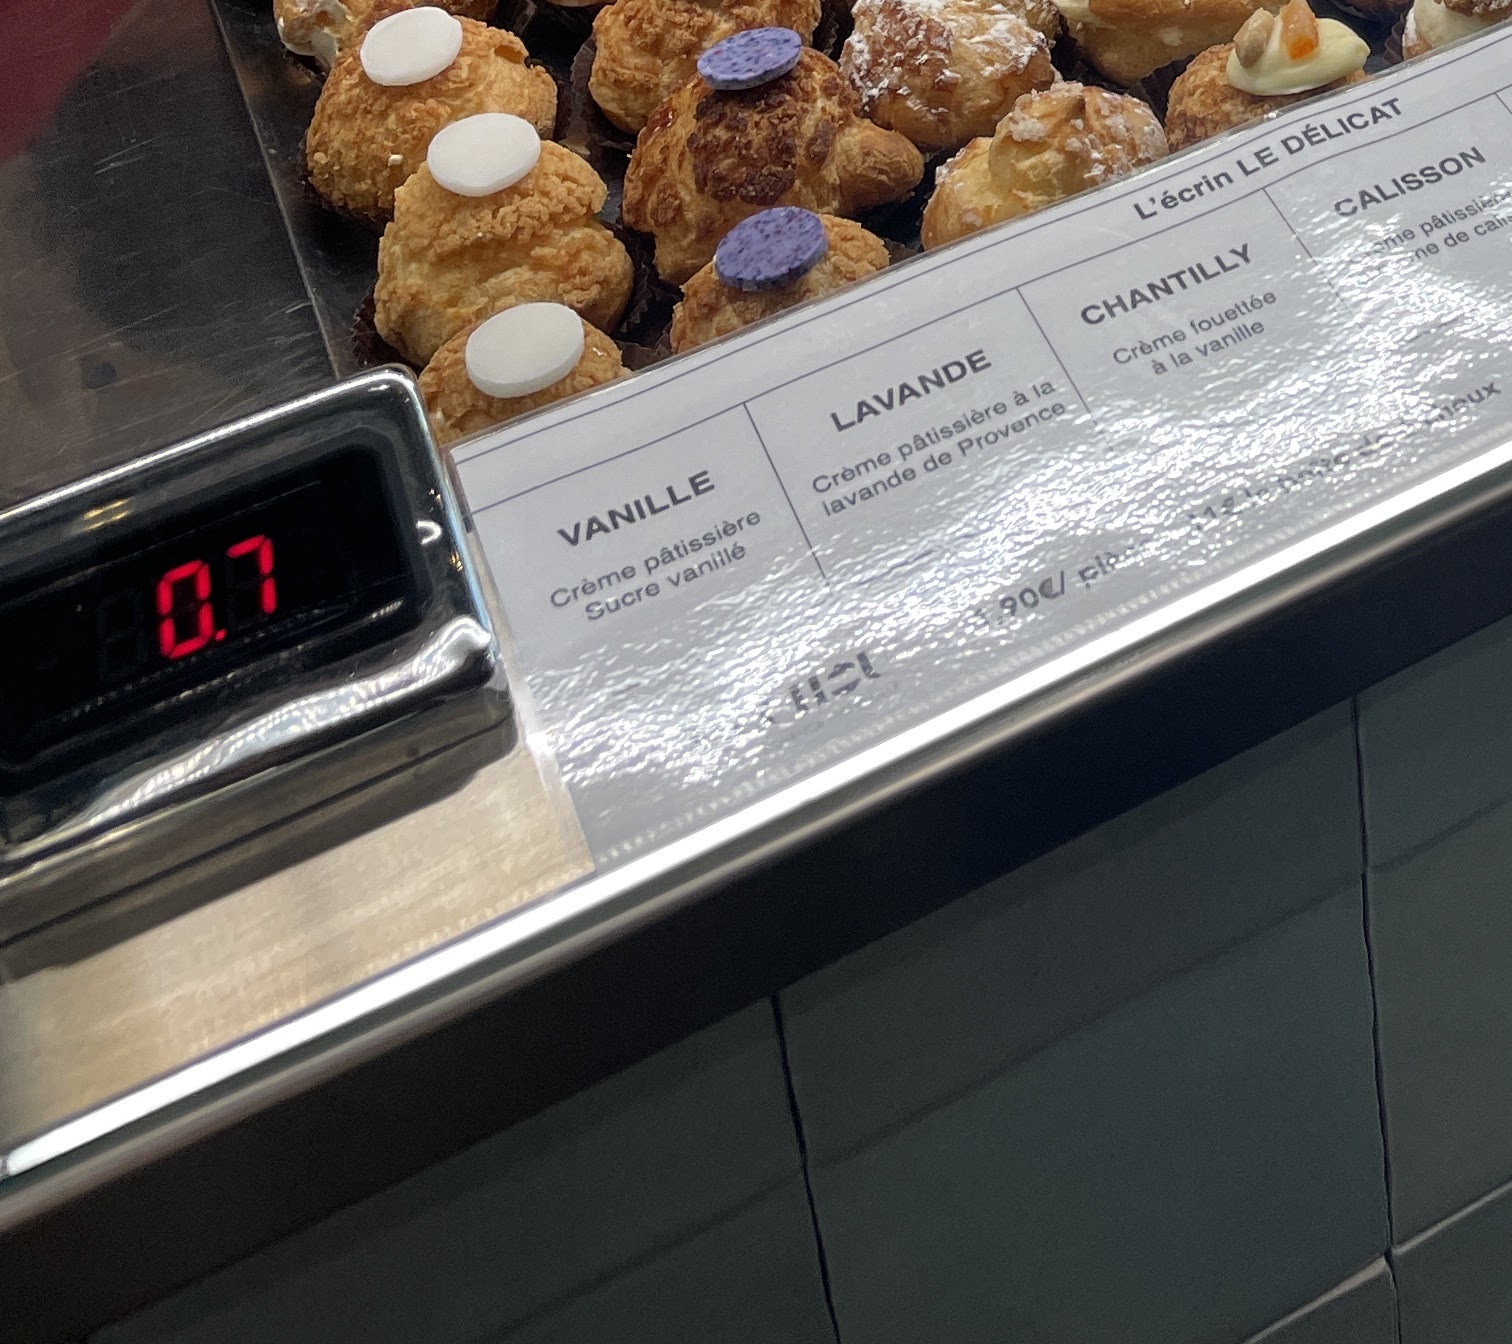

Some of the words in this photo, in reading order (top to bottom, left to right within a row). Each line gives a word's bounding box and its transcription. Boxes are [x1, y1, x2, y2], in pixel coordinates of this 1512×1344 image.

[1133, 171, 1234, 220] L'écrin
[1236, 146, 1279, 177] LE
[1281, 96, 1402, 155] DÉLICAT
[1334, 146, 1487, 217] CALISSON
[1443, 228, 1470, 248] de
[1080, 243, 1252, 325] CHANTILLY
[1113, 328, 1187, 364] Crème
[1189, 291, 1277, 335] fouettée
[1151, 359, 1168, 375] à
[1170, 350, 1193, 368] la
[1195, 321, 1265, 358] vanille
[830, 348, 992, 432] LAVANDE
[812, 452, 892, 493] Crème
[897, 401, 1007, 461] pâtissière
[1013, 390, 1030, 407] à
[1033, 380, 1056, 399] la
[822, 467, 917, 516] lavande
[922, 449, 952, 473] de
[957, 402, 1066, 457] Provence
[557, 470, 716, 547] VANILLE
[156, 534, 277, 660] 0.7
[550, 565, 637, 608] Crème
[644, 511, 761, 575] pâtissière
[585, 582, 661, 620] Sucre
[667, 542, 746, 587] vanillé
